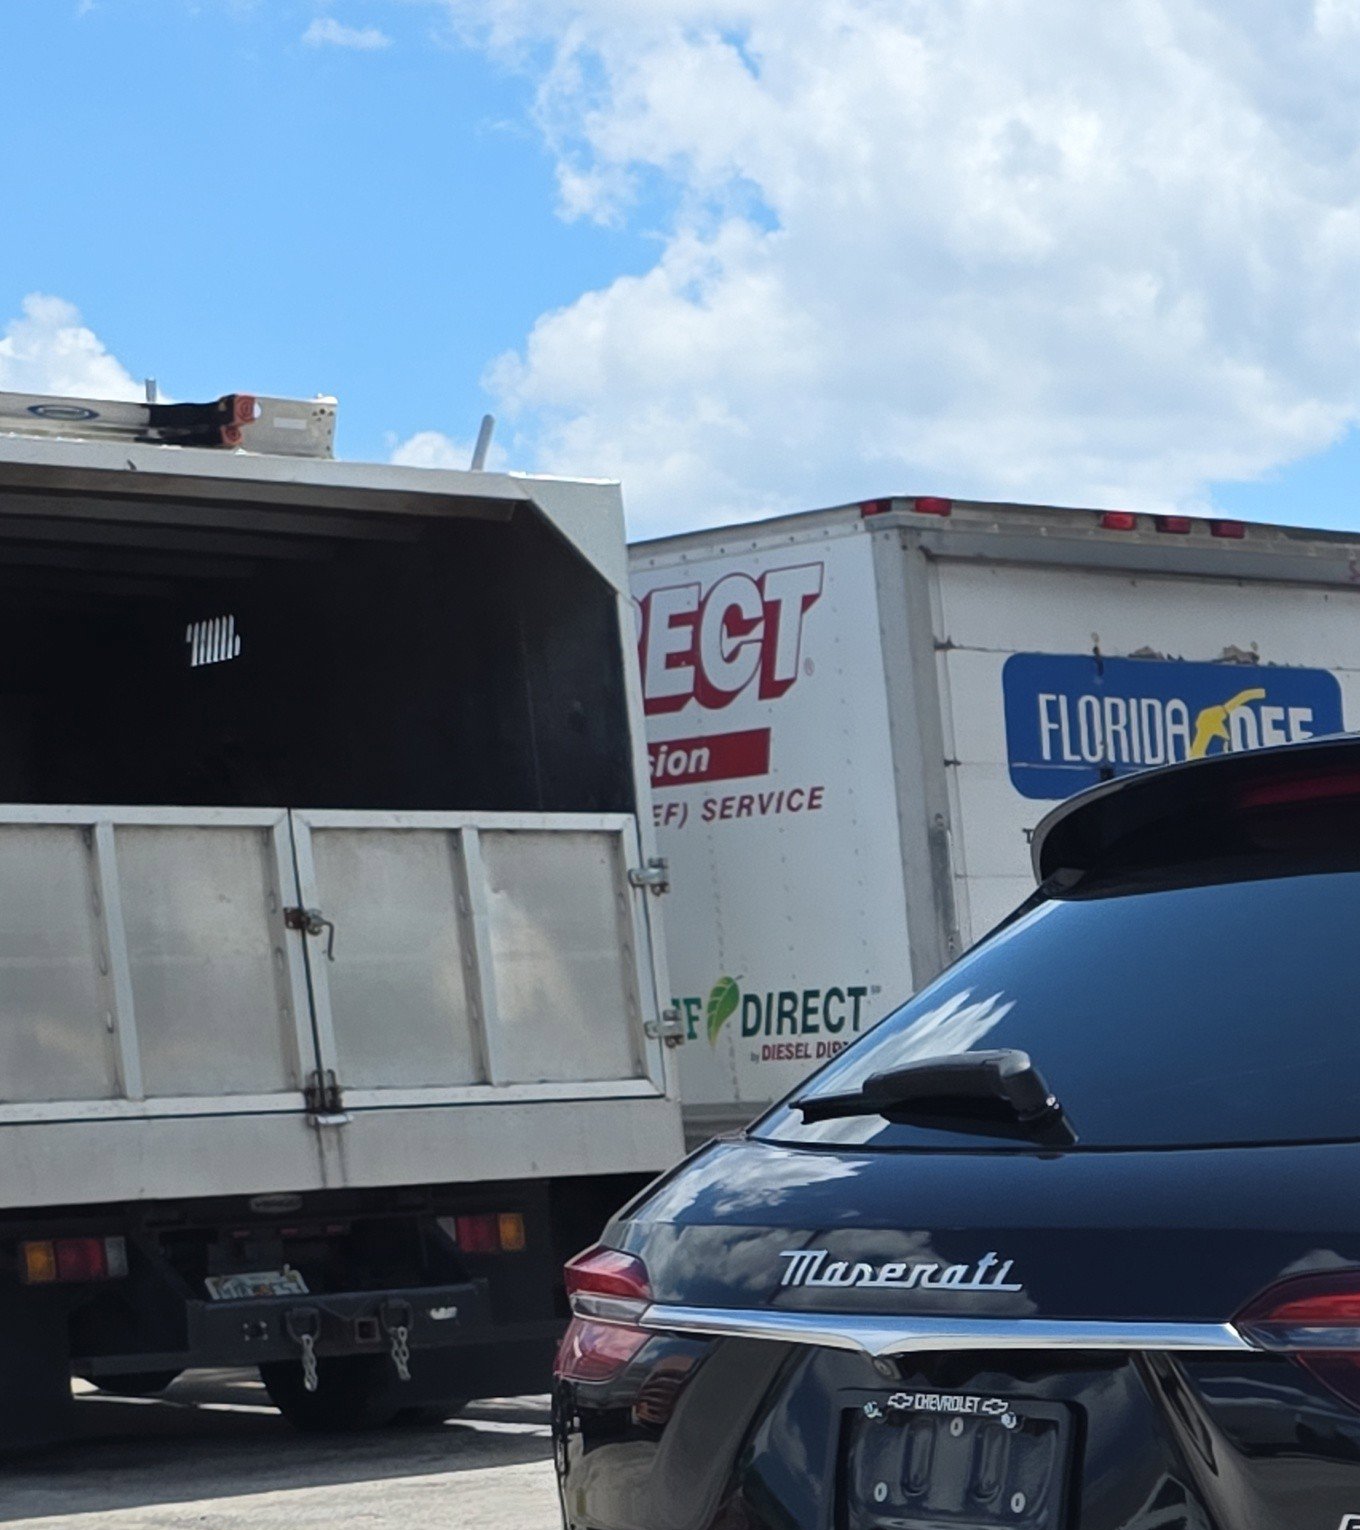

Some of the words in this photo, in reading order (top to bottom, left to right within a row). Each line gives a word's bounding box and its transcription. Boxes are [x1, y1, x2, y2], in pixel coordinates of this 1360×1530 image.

[632, 561, 825, 717] ECT
[1038, 693, 1192, 764] FLORIDA
[701, 786, 825, 822] SERVICE
[741, 986, 868, 1037] DIRECT
[762, 1042, 812, 1061] DIESEL
[779, 1249, 1022, 1291] Maserati
[914, 1393, 982, 1413] CHEVROLET
